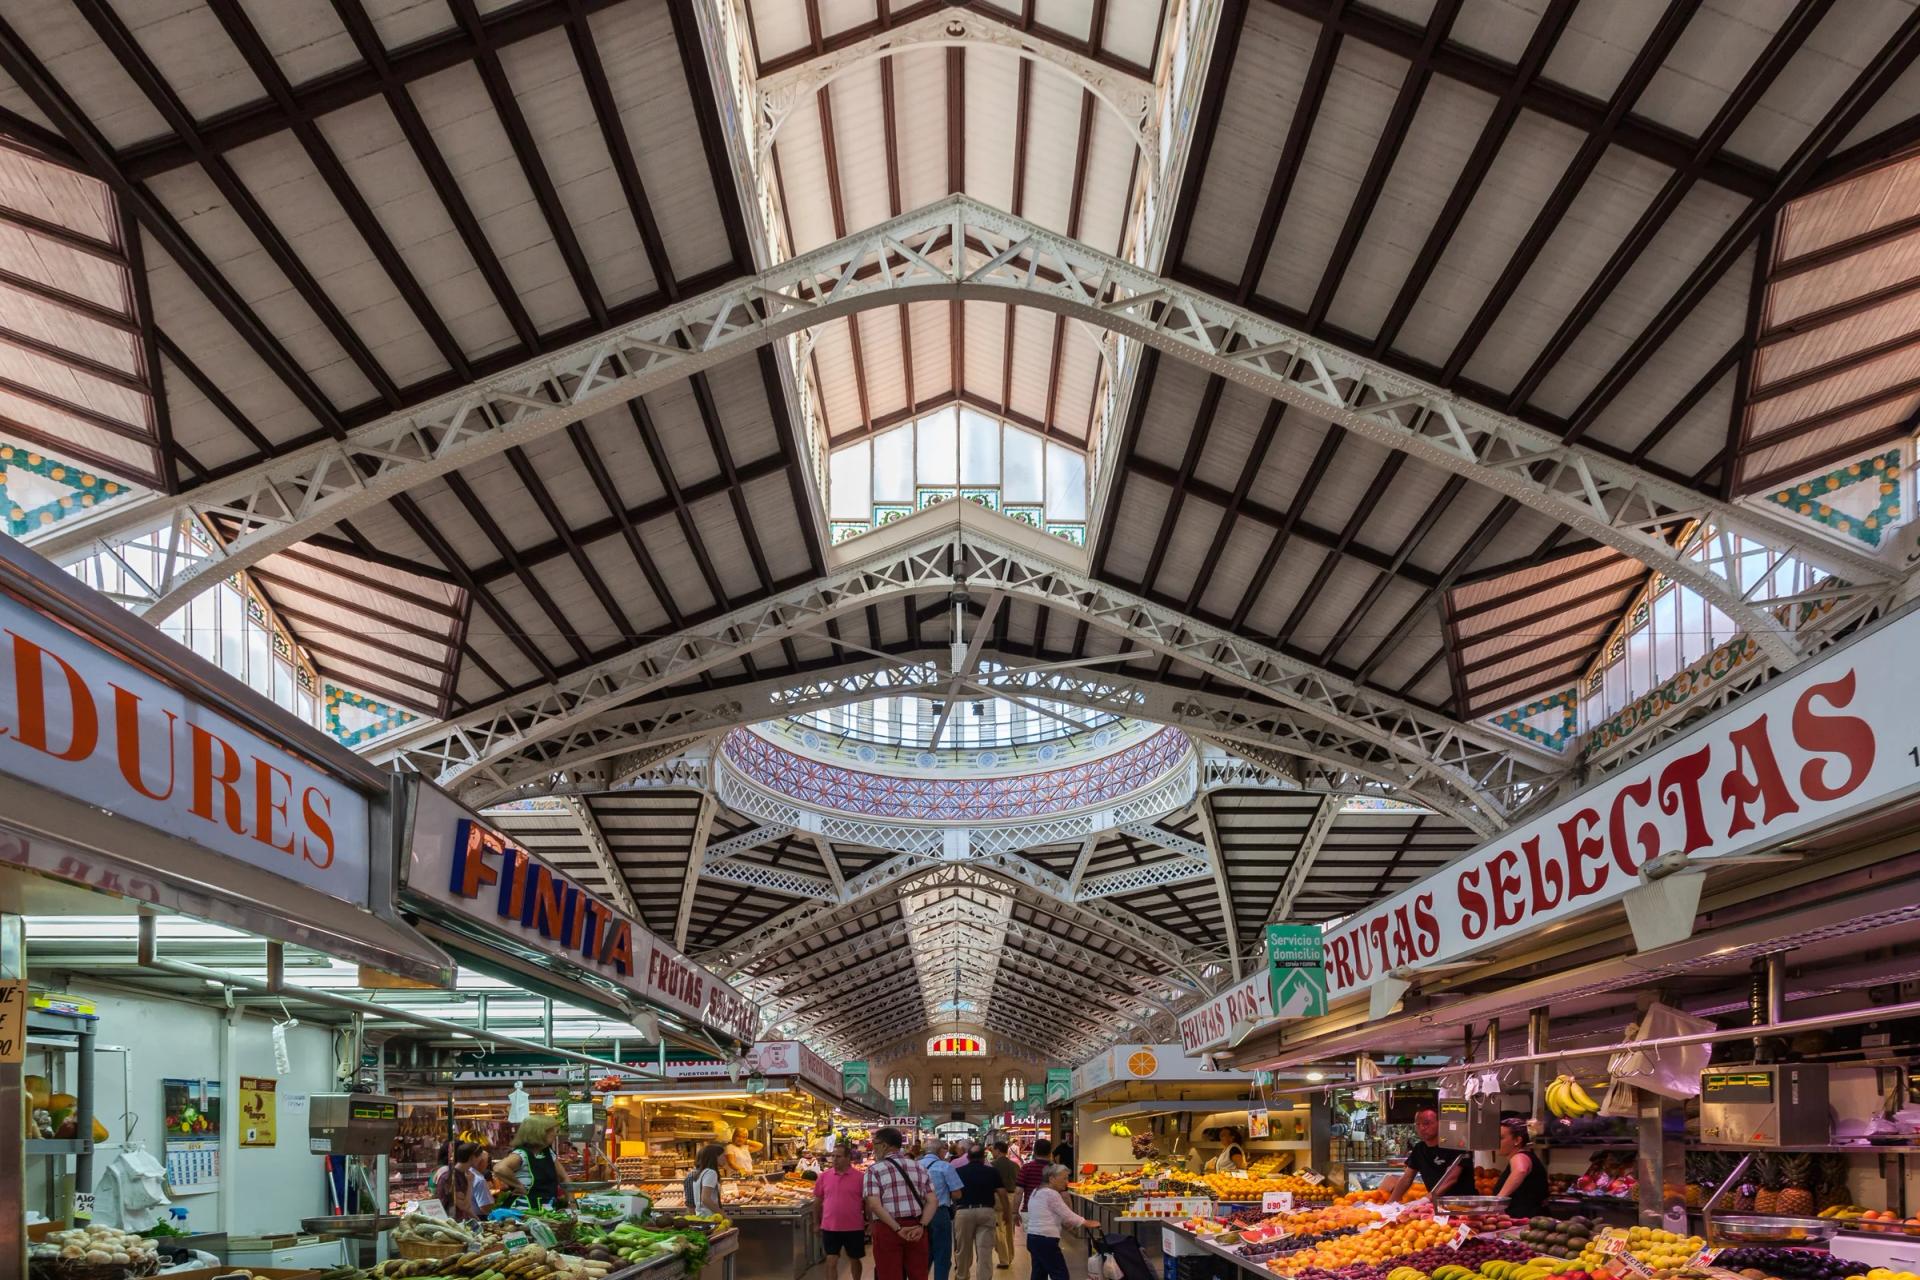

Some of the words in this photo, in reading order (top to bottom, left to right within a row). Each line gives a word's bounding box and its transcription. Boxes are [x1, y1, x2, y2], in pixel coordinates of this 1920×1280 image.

[0, 629, 335, 869] DURES
[1456, 667, 1877, 941] SELECTAS
[449, 818, 635, 978] FINITA
[1270, 933, 1312, 946] Servicio
[1314, 937, 1321, 946] a
[1273, 948, 1320, 960] domicilio
[648, 947, 704, 1009] FRUTAS
[1181, 1002, 1225, 1050] FRUTAS
